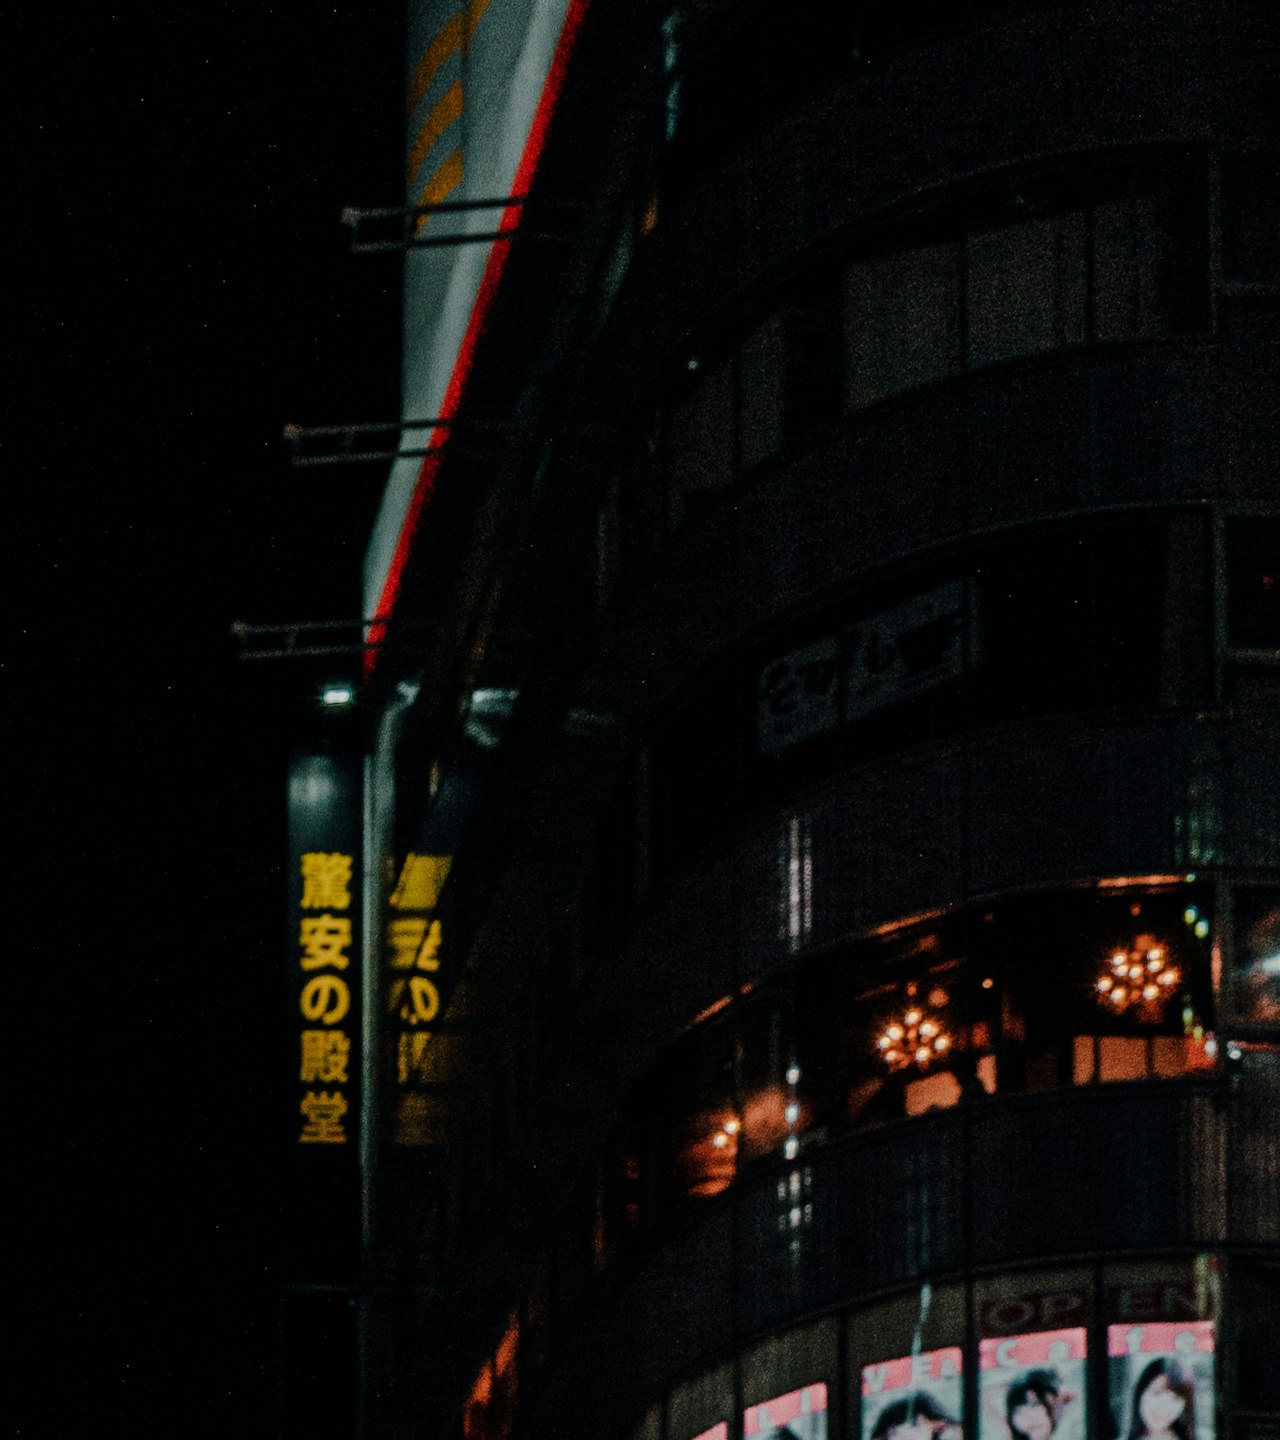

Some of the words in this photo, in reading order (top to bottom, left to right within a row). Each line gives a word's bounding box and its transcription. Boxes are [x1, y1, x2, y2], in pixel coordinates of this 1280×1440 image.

[298, 851, 353, 1146] 驚安の殿堂
